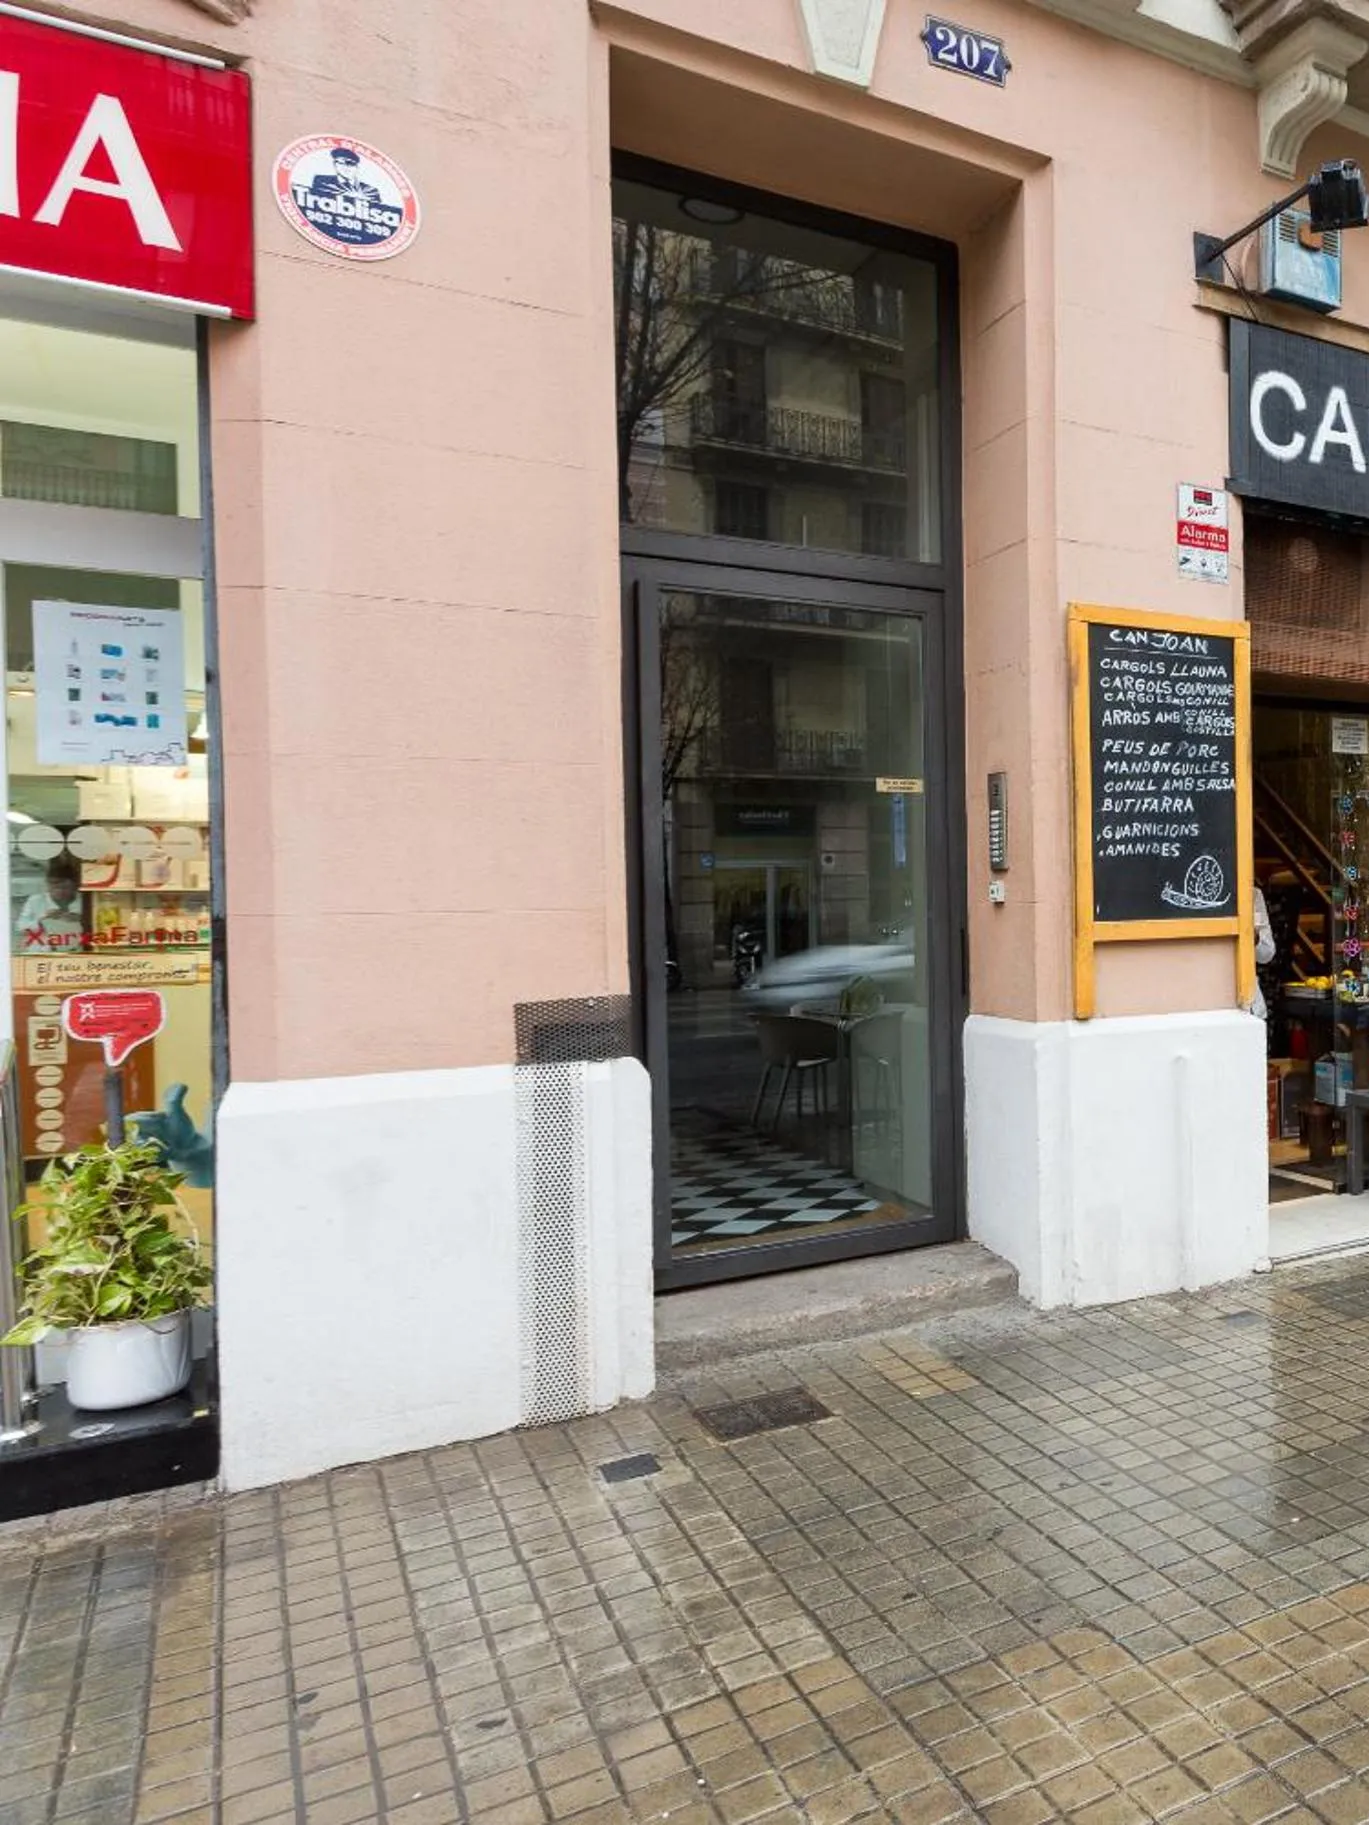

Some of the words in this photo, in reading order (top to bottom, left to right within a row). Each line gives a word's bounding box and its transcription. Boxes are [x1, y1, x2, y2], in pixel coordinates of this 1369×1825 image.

[936, 27, 999, 77] 207
[292, 184, 400, 227] Trablisa
[1109, 629, 1148, 645] CAN
[1150, 632, 1209, 655] JOAN
[1100, 658, 1166, 675] CARGOLS
[1170, 662, 1228, 678] LLAUNA
[1100, 676, 1172, 695] CARGOLS
[1104, 691, 1172, 704] CARGOLS
[1155, 711, 1182, 725] AMB
[1102, 738, 1145, 756] PEUS
[1149, 742, 1172, 756] DE
[1175, 740, 1219, 758] PORC
[1104, 779, 1157, 793] CONILL
[1161, 777, 1194, 792] AMB
[1101, 796, 1194, 813] BUTIFARRA
